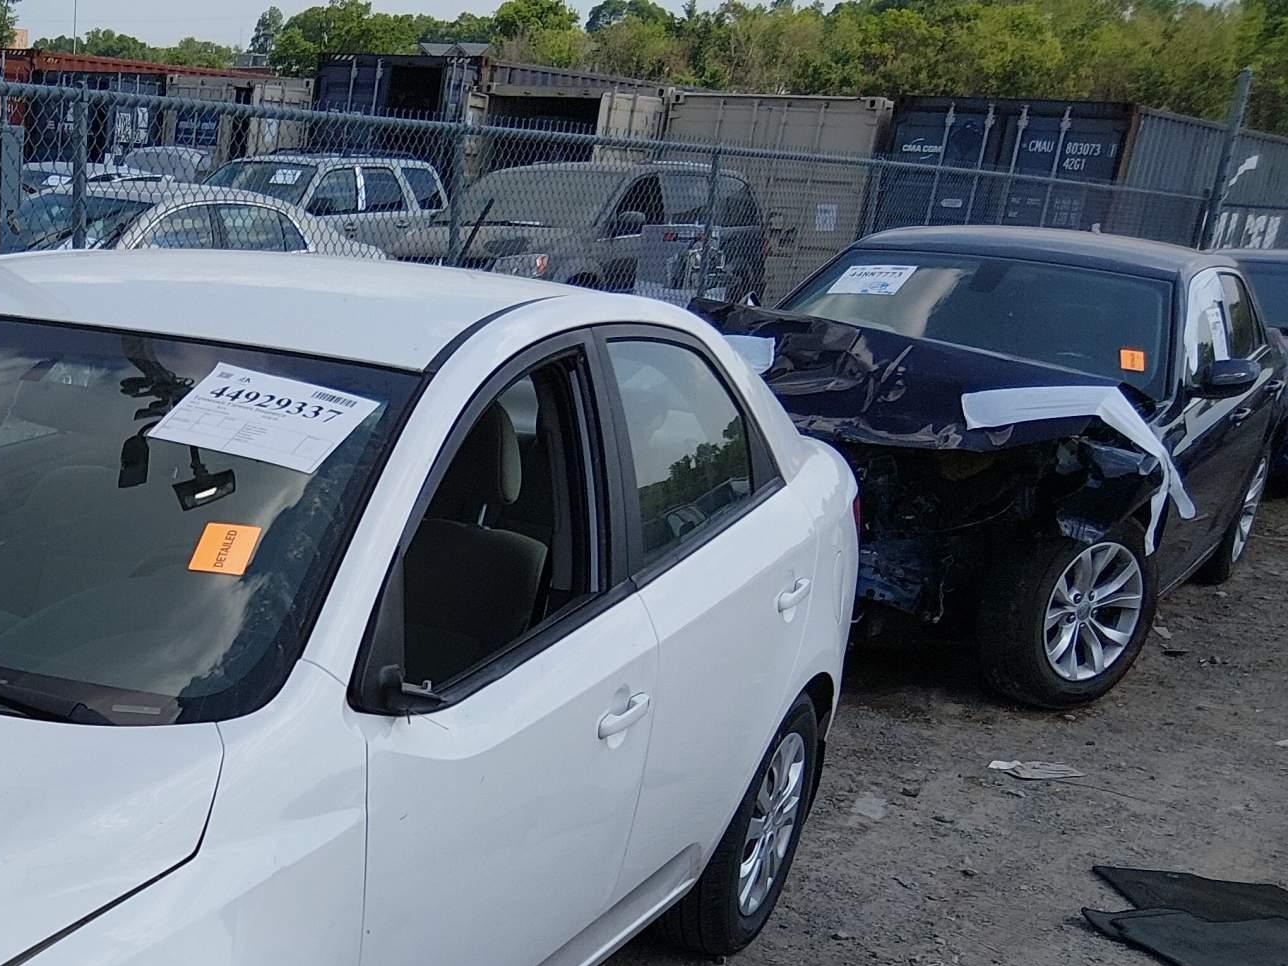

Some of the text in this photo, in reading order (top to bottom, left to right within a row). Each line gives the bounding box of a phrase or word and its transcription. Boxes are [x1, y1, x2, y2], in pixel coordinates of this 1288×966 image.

[1028, 140, 1054, 153] CMAU
[1065, 142, 1101, 156] 803073
[1062, 158, 1086, 171] 42G1
[210, 386, 344, 424] 44929337
[213, 529, 237, 568] DETAILED
